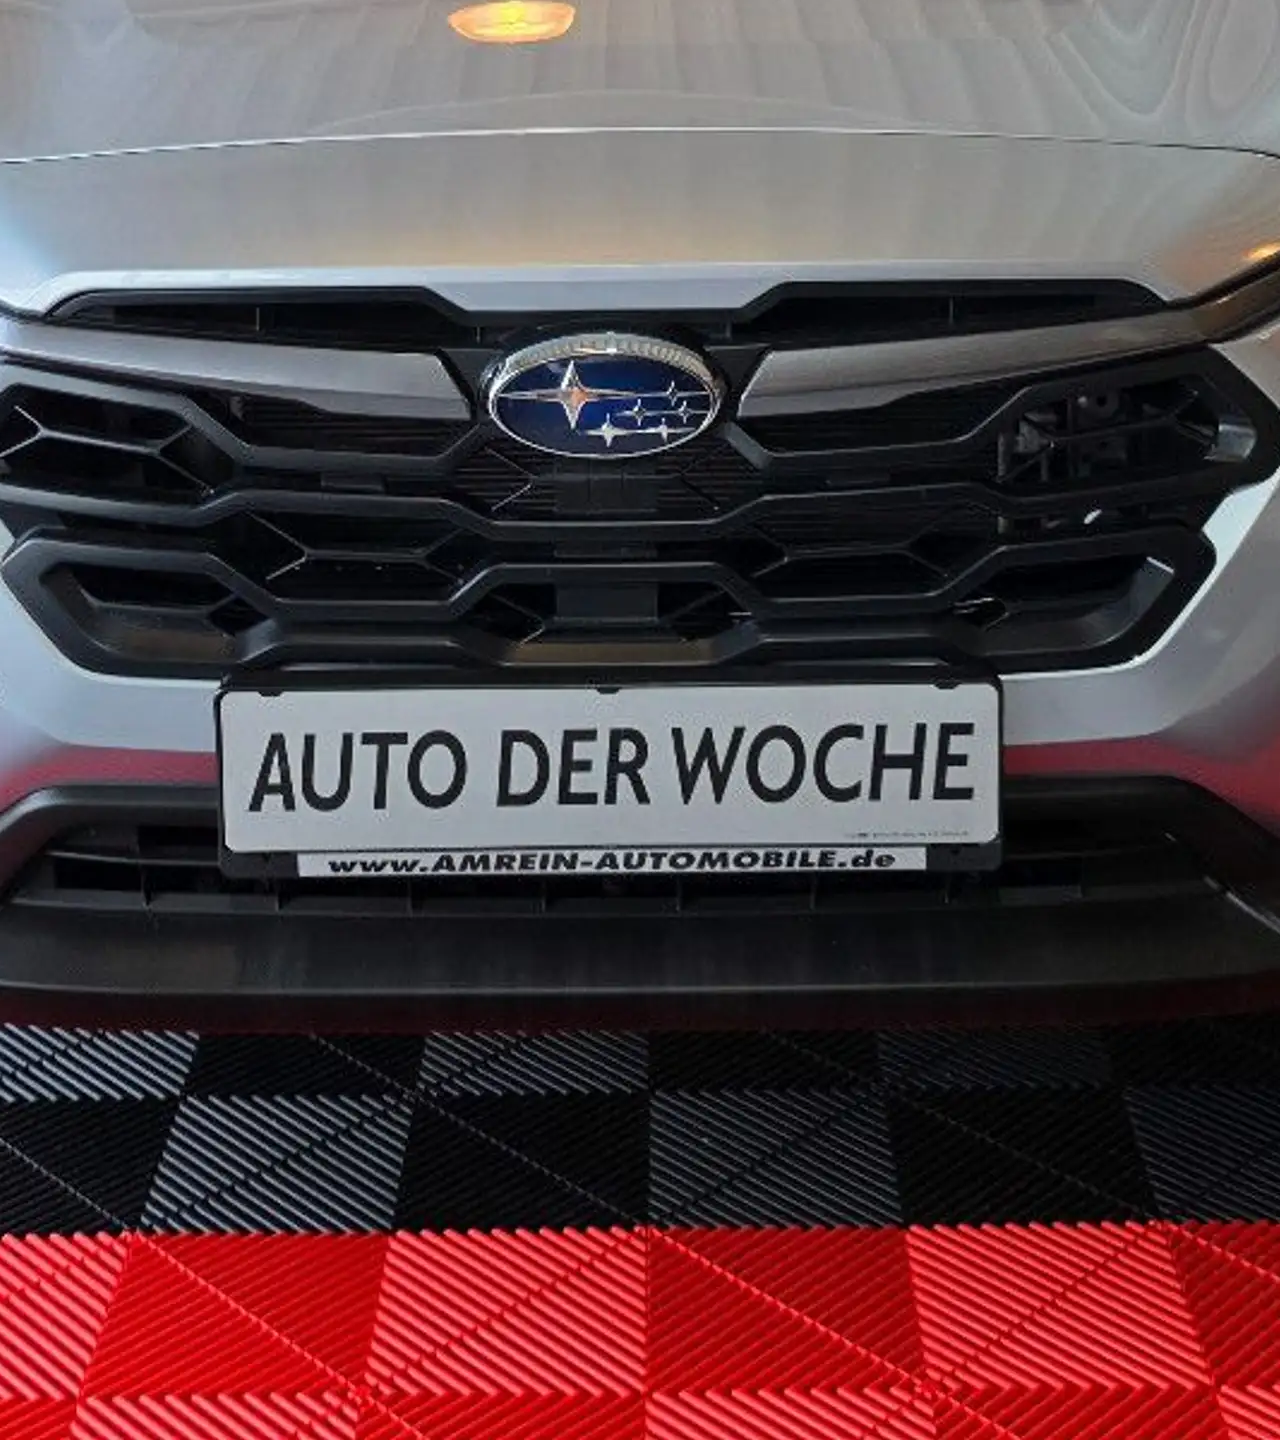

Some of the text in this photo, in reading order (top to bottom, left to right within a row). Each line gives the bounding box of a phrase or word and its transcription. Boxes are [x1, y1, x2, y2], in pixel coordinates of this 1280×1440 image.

[248, 722, 975, 812] AUTO DER WOCHE
[328, 849, 896, 873] www.AMREIN-AUTOMOBILE.de
